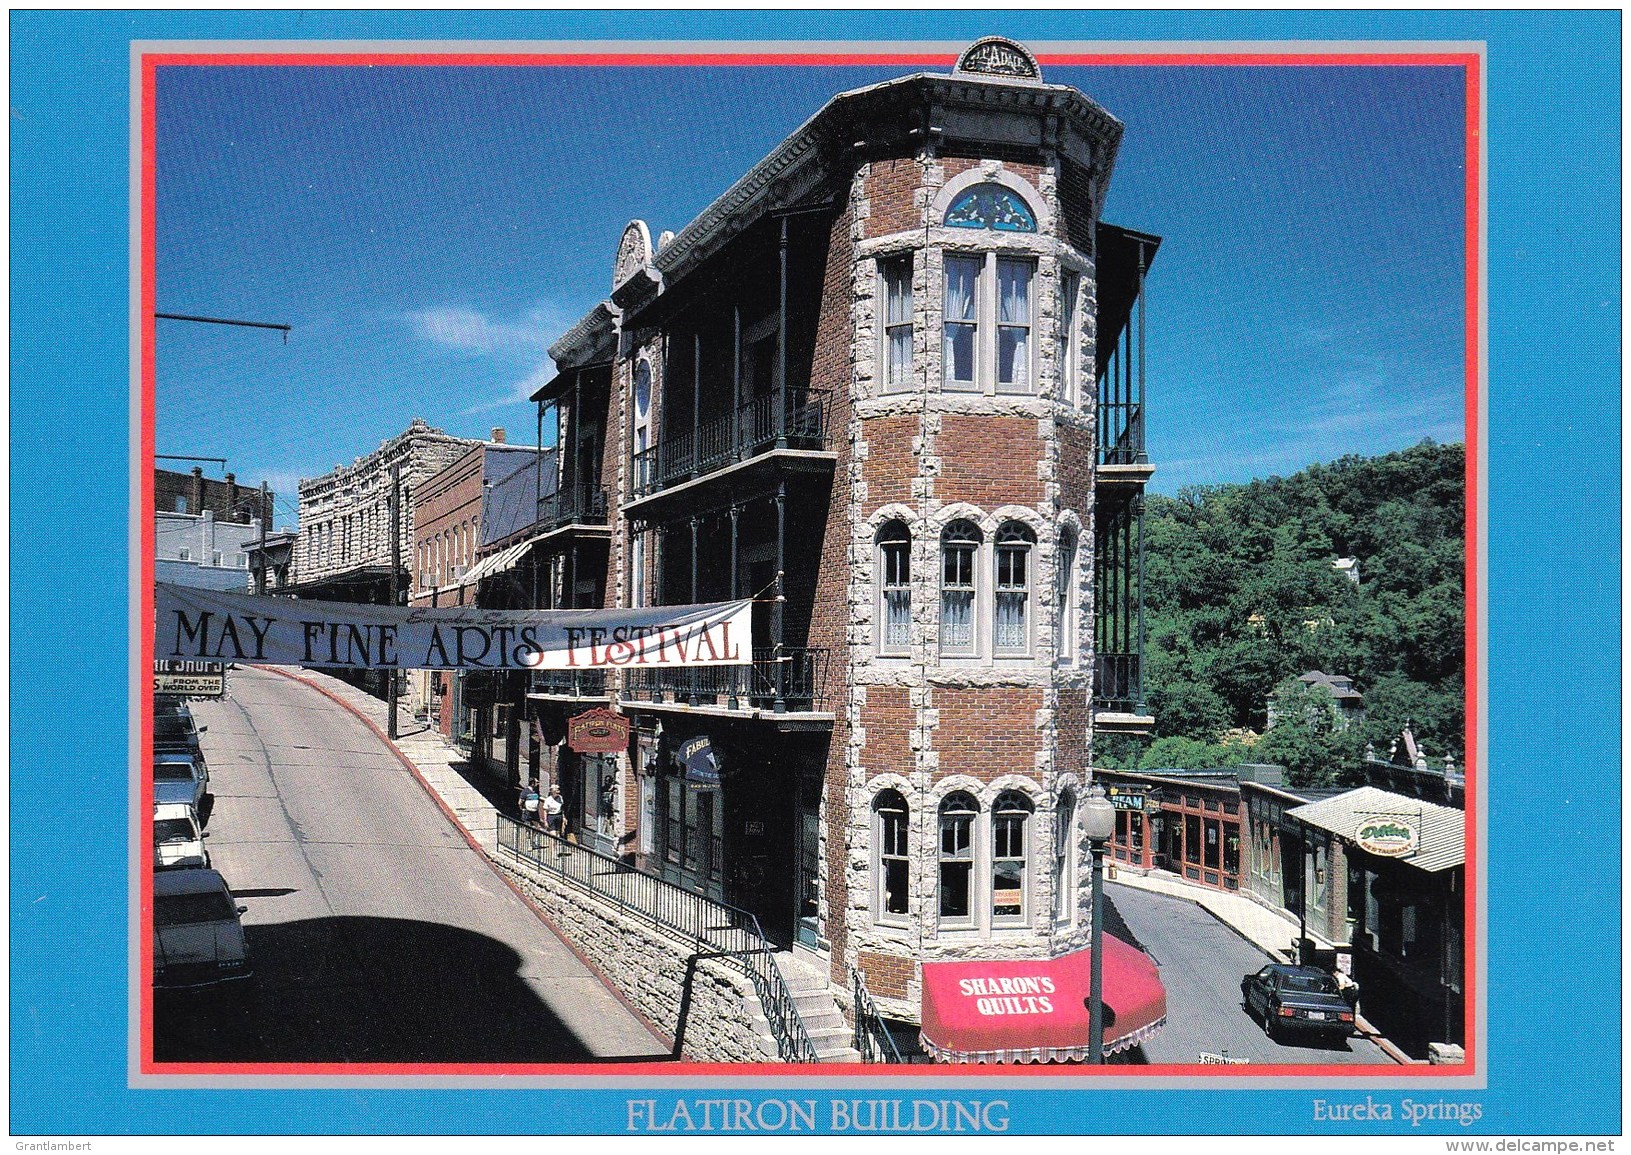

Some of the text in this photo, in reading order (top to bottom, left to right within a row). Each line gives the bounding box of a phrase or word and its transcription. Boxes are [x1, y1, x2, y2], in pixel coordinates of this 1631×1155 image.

[171, 610, 740, 668] MAY FINE ARTS FESTIVAL
[1361, 842, 1412, 854] RESTAURANT
[959, 976, 1056, 996] SHARON'S
[977, 996, 1054, 1016] QUILTS
